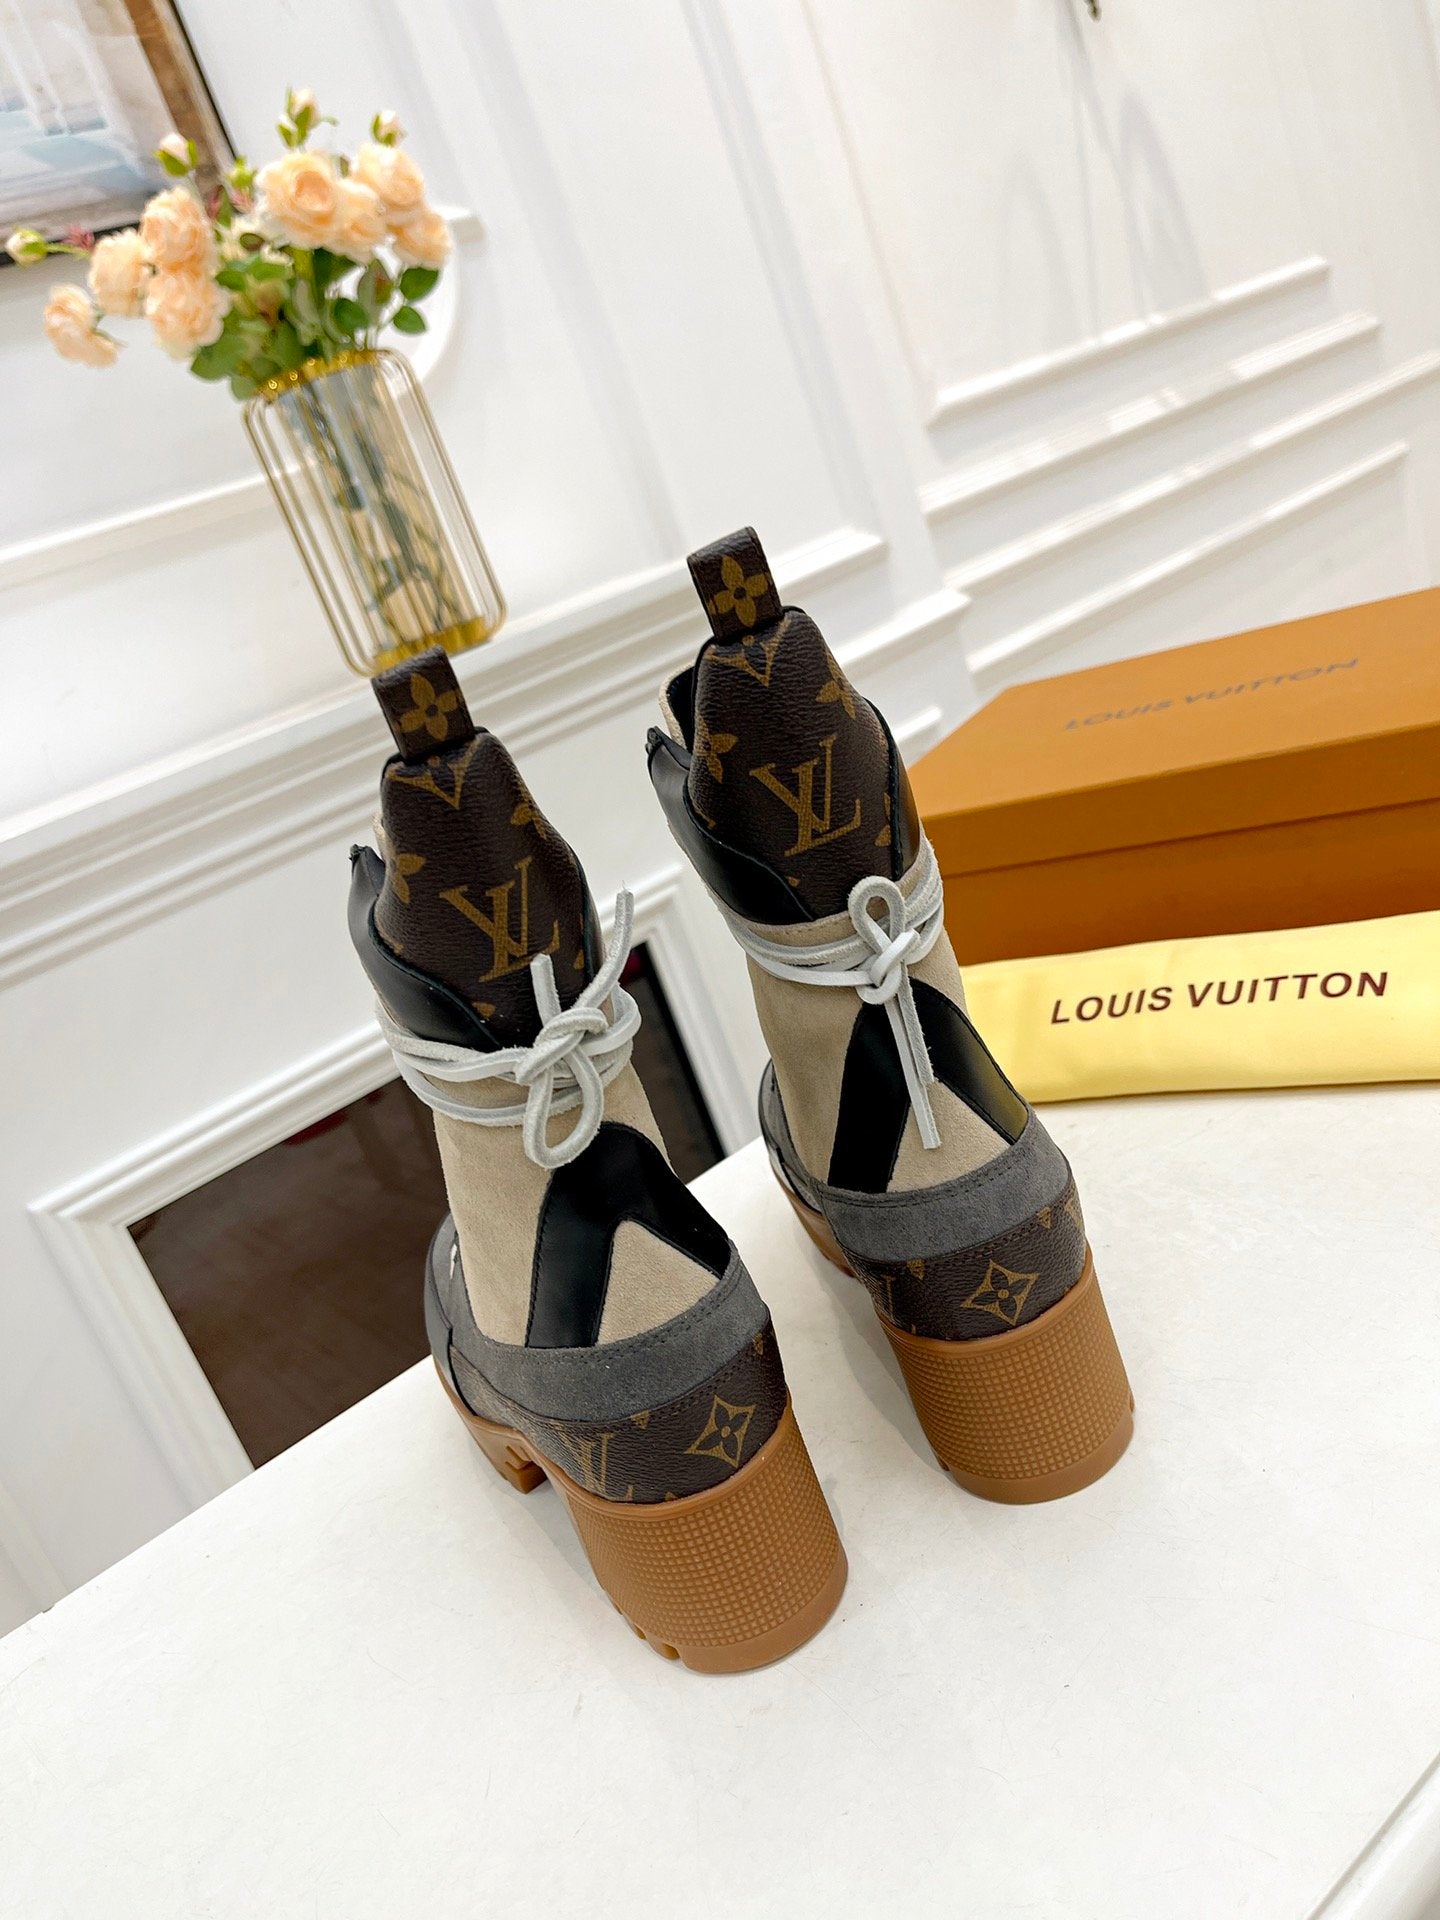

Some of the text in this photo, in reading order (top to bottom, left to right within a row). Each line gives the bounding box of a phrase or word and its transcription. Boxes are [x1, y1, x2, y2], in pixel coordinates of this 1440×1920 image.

[1065, 658, 1359, 731] LOUIS VUITTON
[1050, 971, 1389, 1025] LOUIS VUITTON
